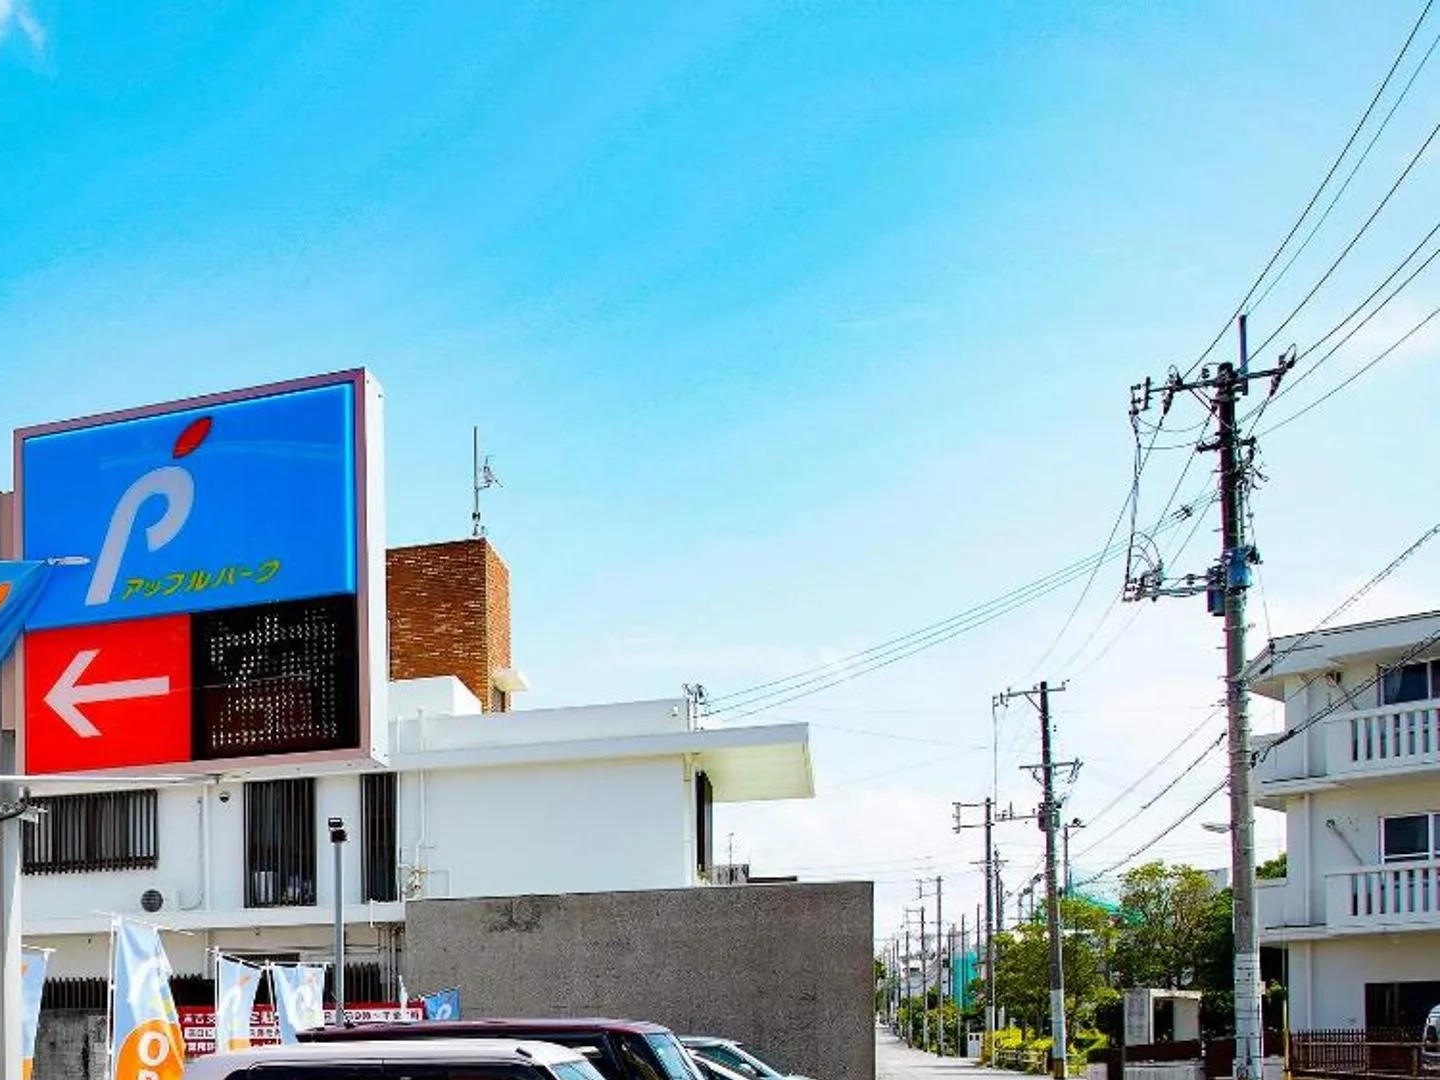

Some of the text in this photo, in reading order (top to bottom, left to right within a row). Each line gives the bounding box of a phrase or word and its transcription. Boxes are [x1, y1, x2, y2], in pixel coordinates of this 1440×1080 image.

[123, 559, 281, 600] アップルパーク
